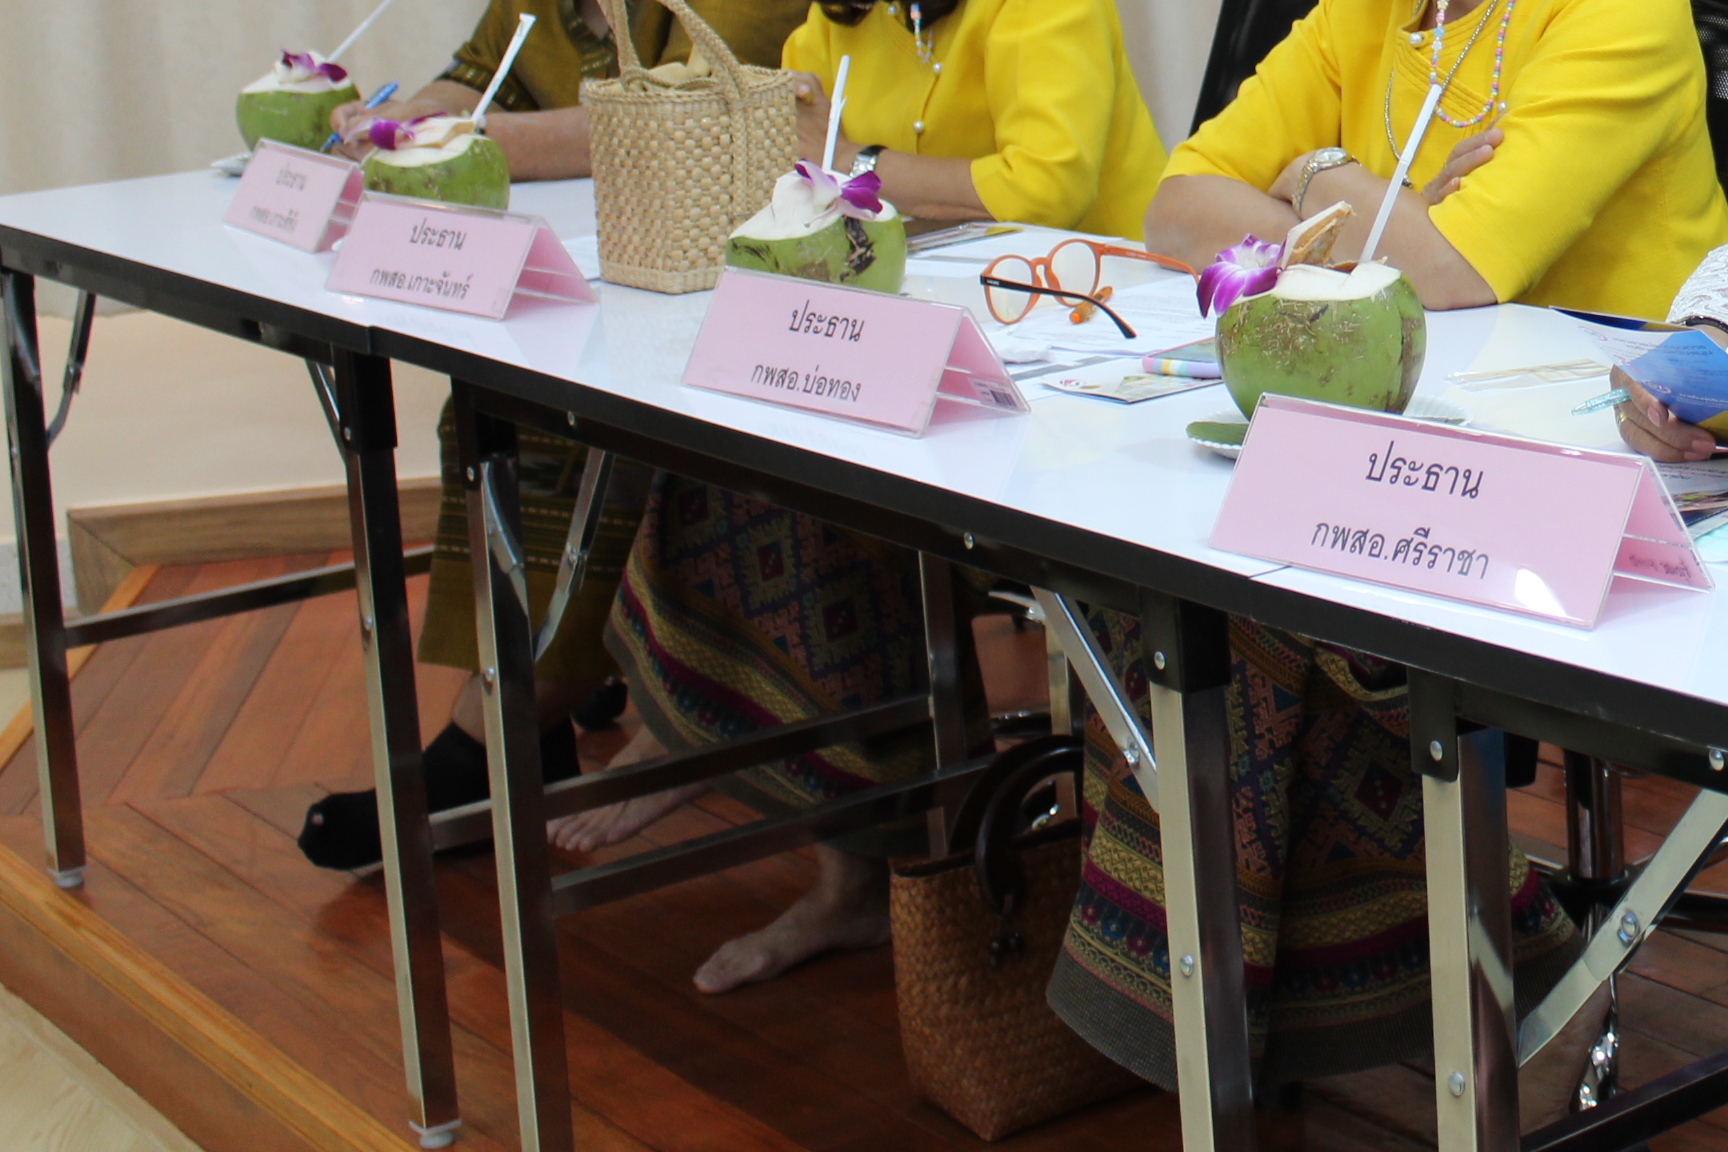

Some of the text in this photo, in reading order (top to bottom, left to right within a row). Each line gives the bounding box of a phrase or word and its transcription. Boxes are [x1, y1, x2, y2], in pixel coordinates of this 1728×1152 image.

[410, 217, 467, 250] ประธาน
[369, 269, 474, 300] กพสอ.เกาะจันทร์
[789, 299, 865, 342] ประธาน
[750, 364, 861, 402] กพสอ.บ่อทอง
[1366, 440, 1484, 499] ประธาน
[1311, 521, 1490, 579] กพสอ.ศรีราชา
